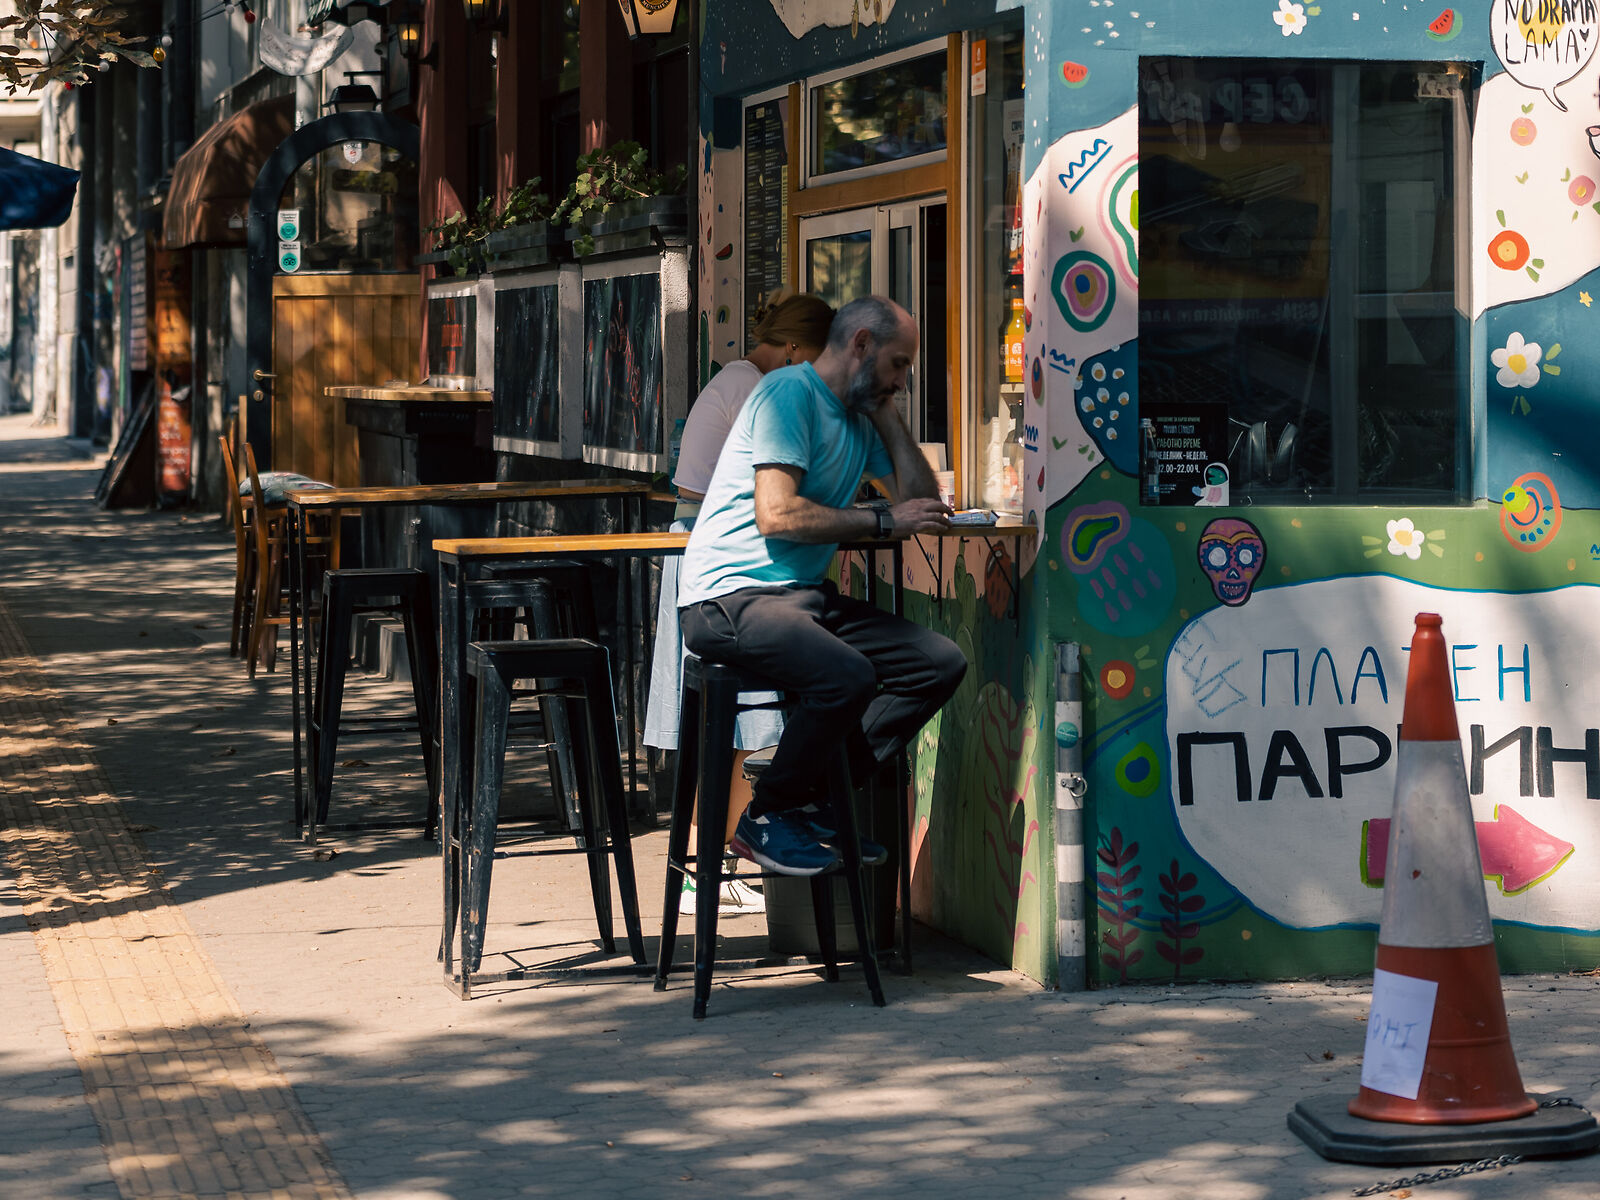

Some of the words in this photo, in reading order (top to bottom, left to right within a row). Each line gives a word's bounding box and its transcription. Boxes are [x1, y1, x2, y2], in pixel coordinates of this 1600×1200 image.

[1157, 438, 1182, 448] РАБОТНО
[1183, 438, 1201, 448] ВРЕМЕ
[1262, 643, 1532, 707] ПЛАЕН
[1177, 723, 1600, 806] ПАРИН
